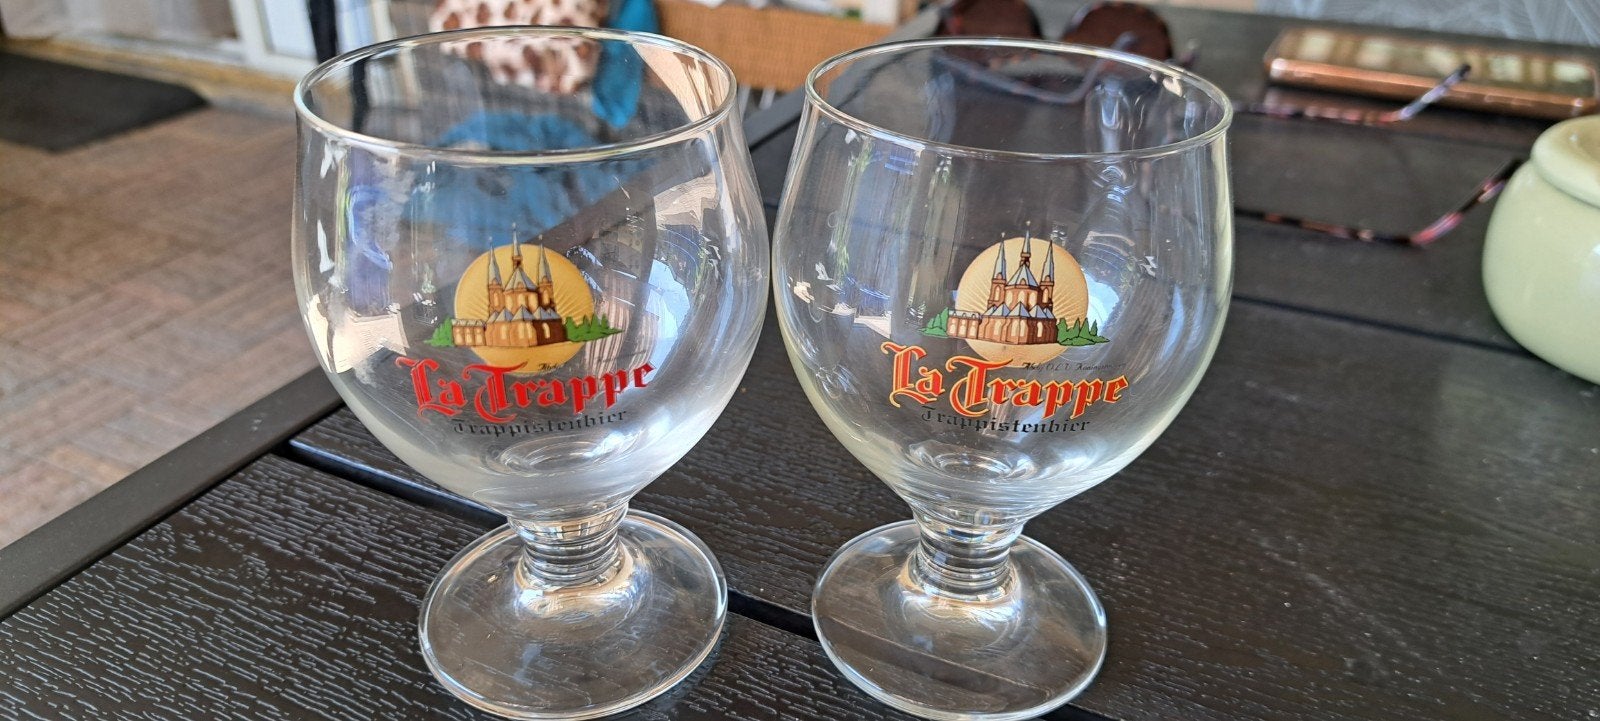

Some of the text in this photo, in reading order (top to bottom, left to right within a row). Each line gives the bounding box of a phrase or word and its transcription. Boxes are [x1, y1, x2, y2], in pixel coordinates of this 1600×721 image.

[395, 356, 656, 423] La Trappe
[881, 342, 1129, 420] La Trappe
[451, 410, 628, 437] Trappistenbier
[922, 405, 1090, 433] Trappistenbier
